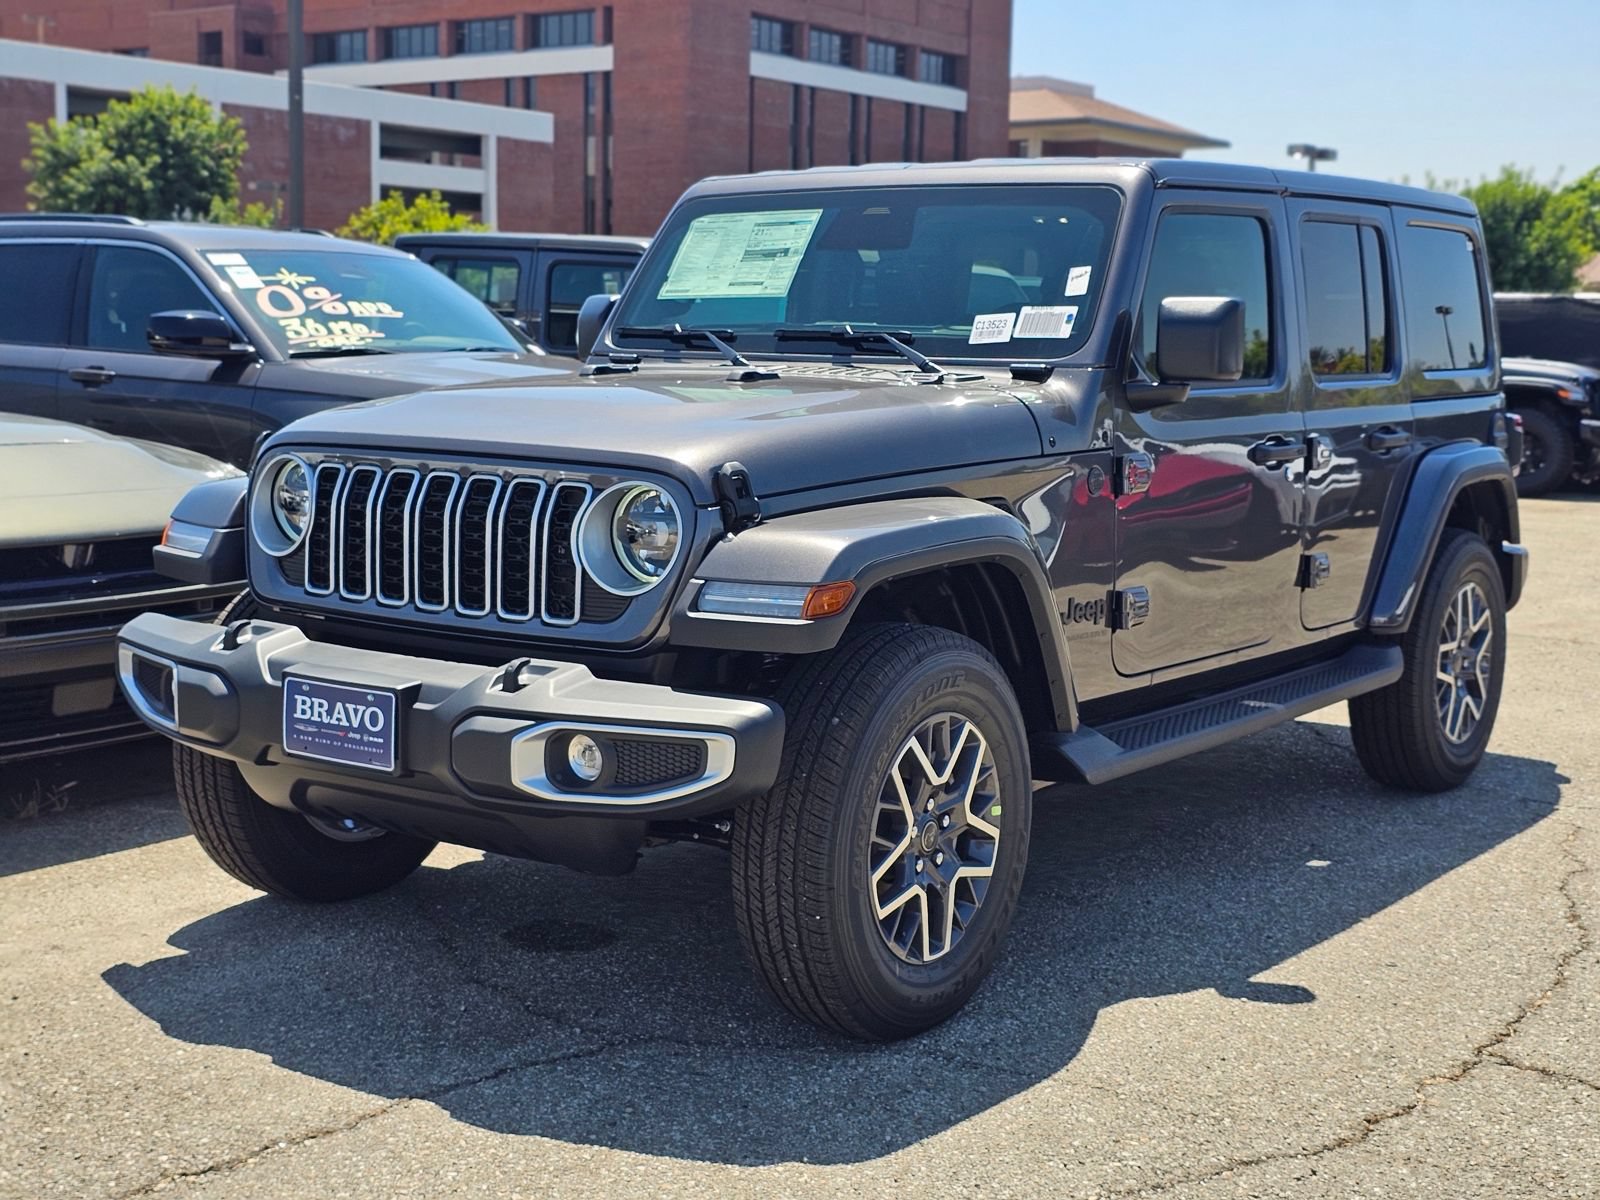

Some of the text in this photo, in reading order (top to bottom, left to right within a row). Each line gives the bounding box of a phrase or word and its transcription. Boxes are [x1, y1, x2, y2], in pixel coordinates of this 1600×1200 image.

[256, 285, 396, 318] 0% APR
[279, 318, 328, 339] 36
[975, 318, 1008, 331] C13523
[1060, 597, 1107, 625] Jeep
[293, 694, 385, 732] BRAVO
[347, 731, 362, 741] Jeep
